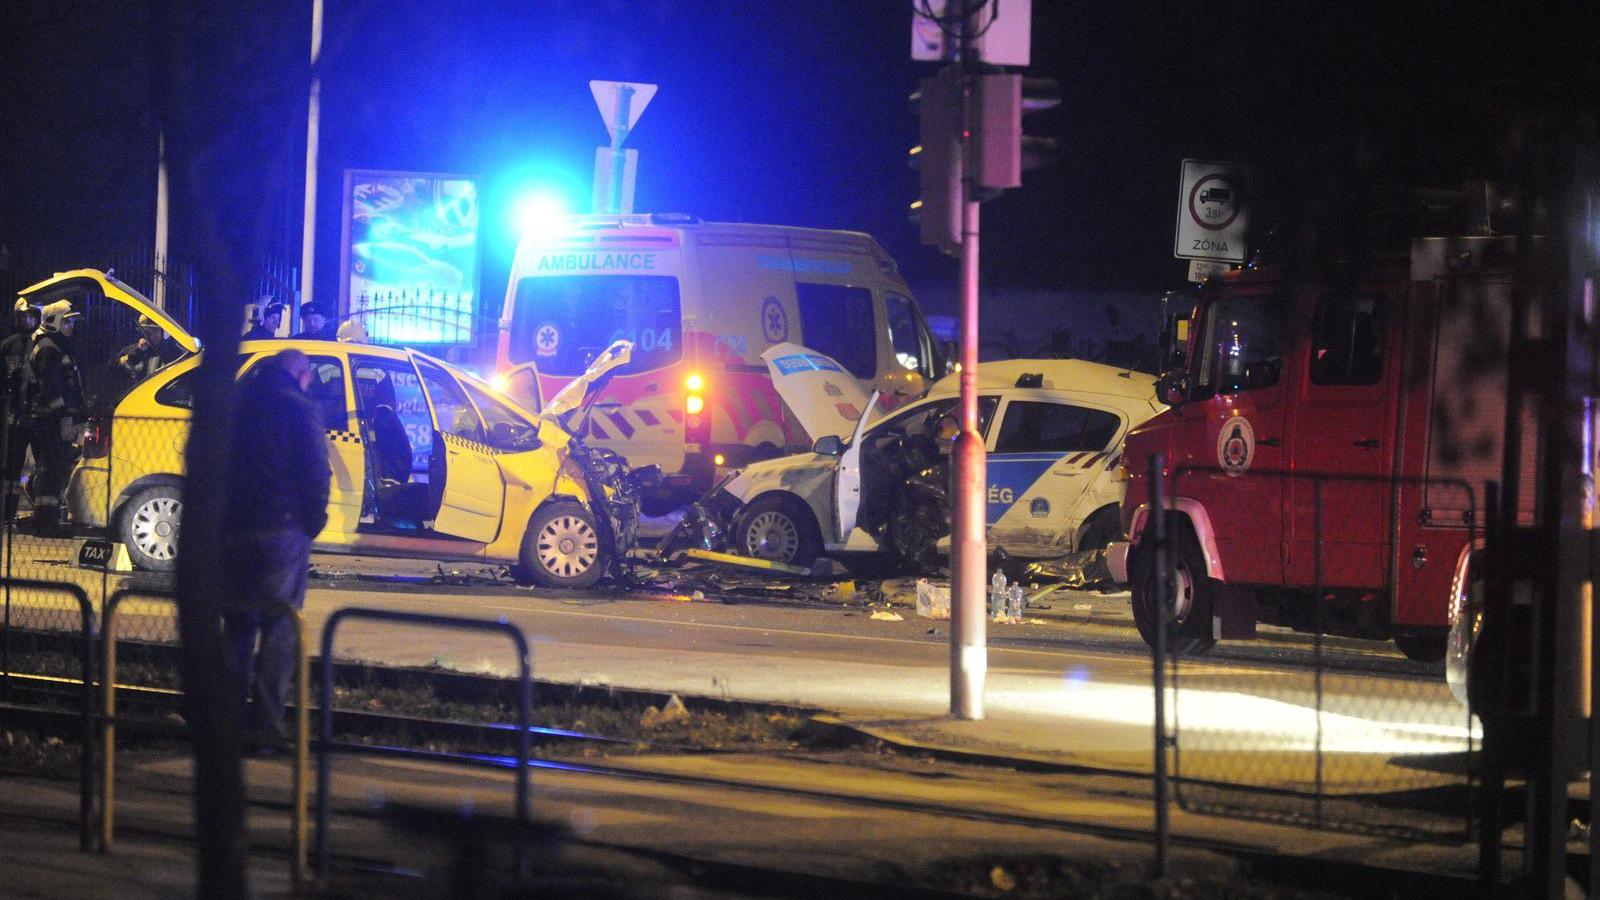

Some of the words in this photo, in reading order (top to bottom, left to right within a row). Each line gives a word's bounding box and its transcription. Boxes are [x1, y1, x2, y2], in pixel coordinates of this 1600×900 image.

[1193, 239, 1228, 253] ZÓNA
[537, 253, 656, 272] AMBULANCE
[988, 484, 1013, 504] ÉG
